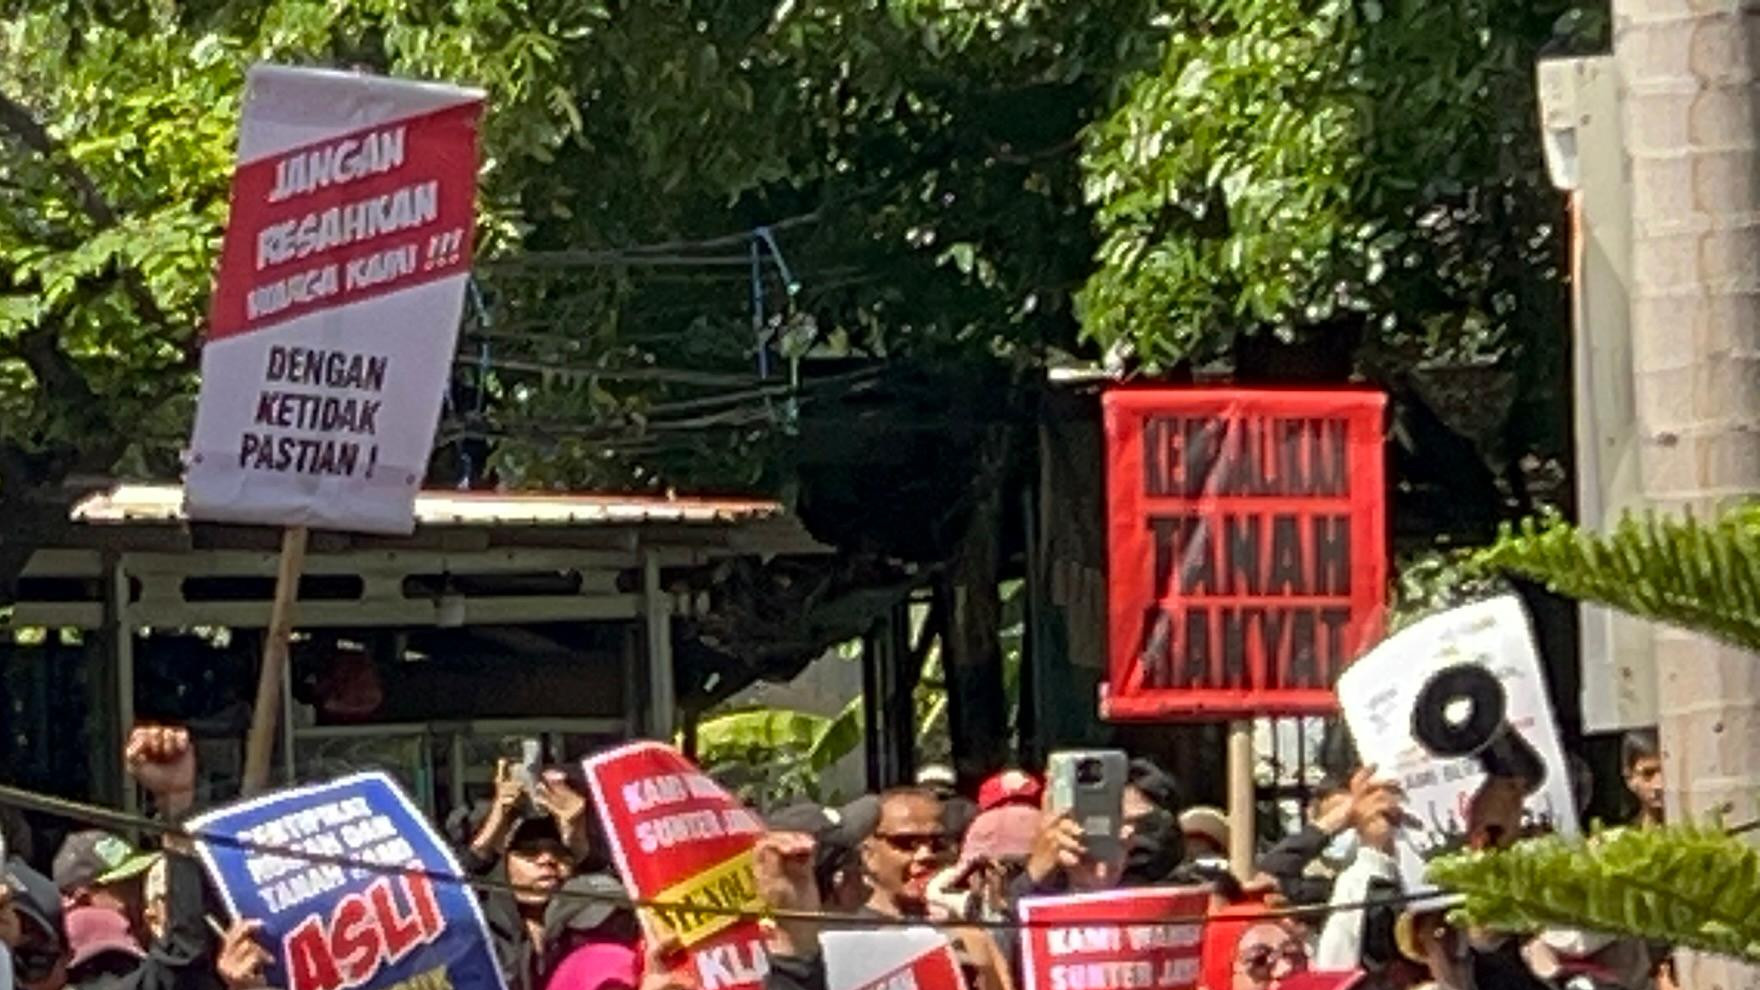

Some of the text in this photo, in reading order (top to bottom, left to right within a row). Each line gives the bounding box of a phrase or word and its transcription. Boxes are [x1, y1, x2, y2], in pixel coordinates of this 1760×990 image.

[269, 127, 406, 203] JANGAN
[257, 181, 438, 271] RESAHKAN
[266, 345, 387, 392] DENGAN
[255, 391, 382, 436] KETIDAK
[240, 433, 359, 476] PASTIAN
[1147, 515, 1352, 597] TANAH
[1143, 606, 1352, 690] RAKYAT
